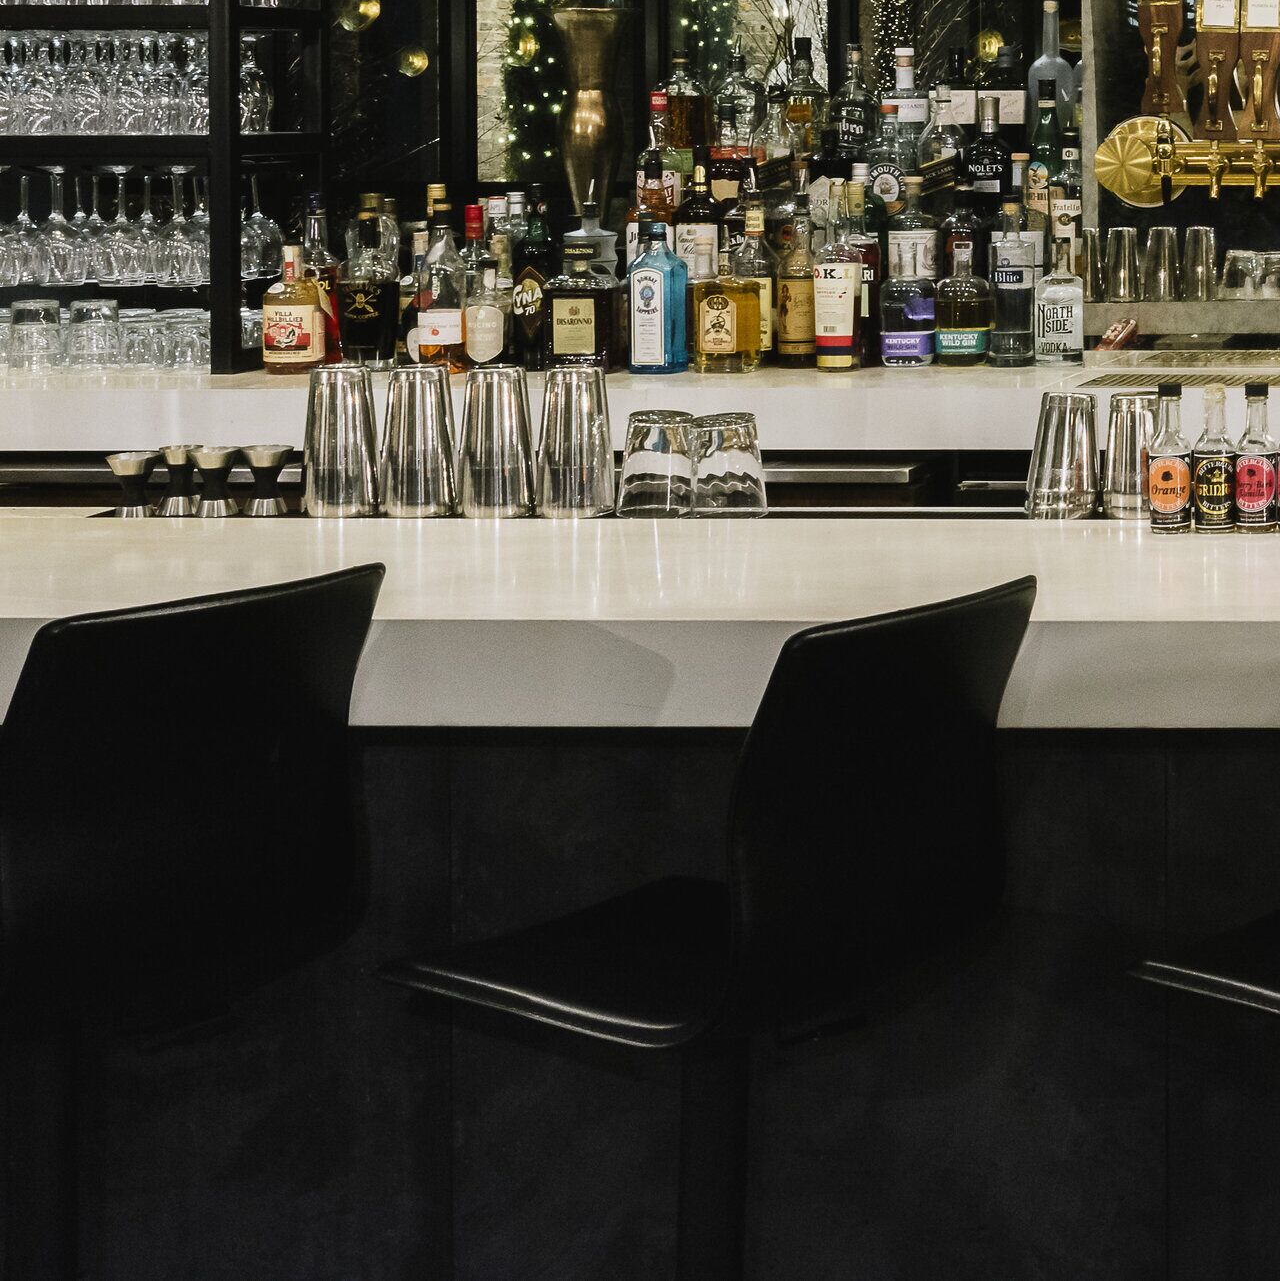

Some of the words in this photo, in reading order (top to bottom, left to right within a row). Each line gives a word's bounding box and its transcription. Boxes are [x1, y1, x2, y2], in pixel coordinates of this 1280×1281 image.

[994, 271, 1020, 282] Blüe
[525, 305, 536, 316] 70
[556, 317, 593, 326] DISARONNO
[1038, 303, 1073, 338] NORTH
[1045, 319, 1069, 334] SIDE
[885, 337, 920, 345] KENTUCKY
[942, 339, 961, 347] WILD
[962, 339, 977, 347] GIN
[1151, 485, 1186, 498] Orange
